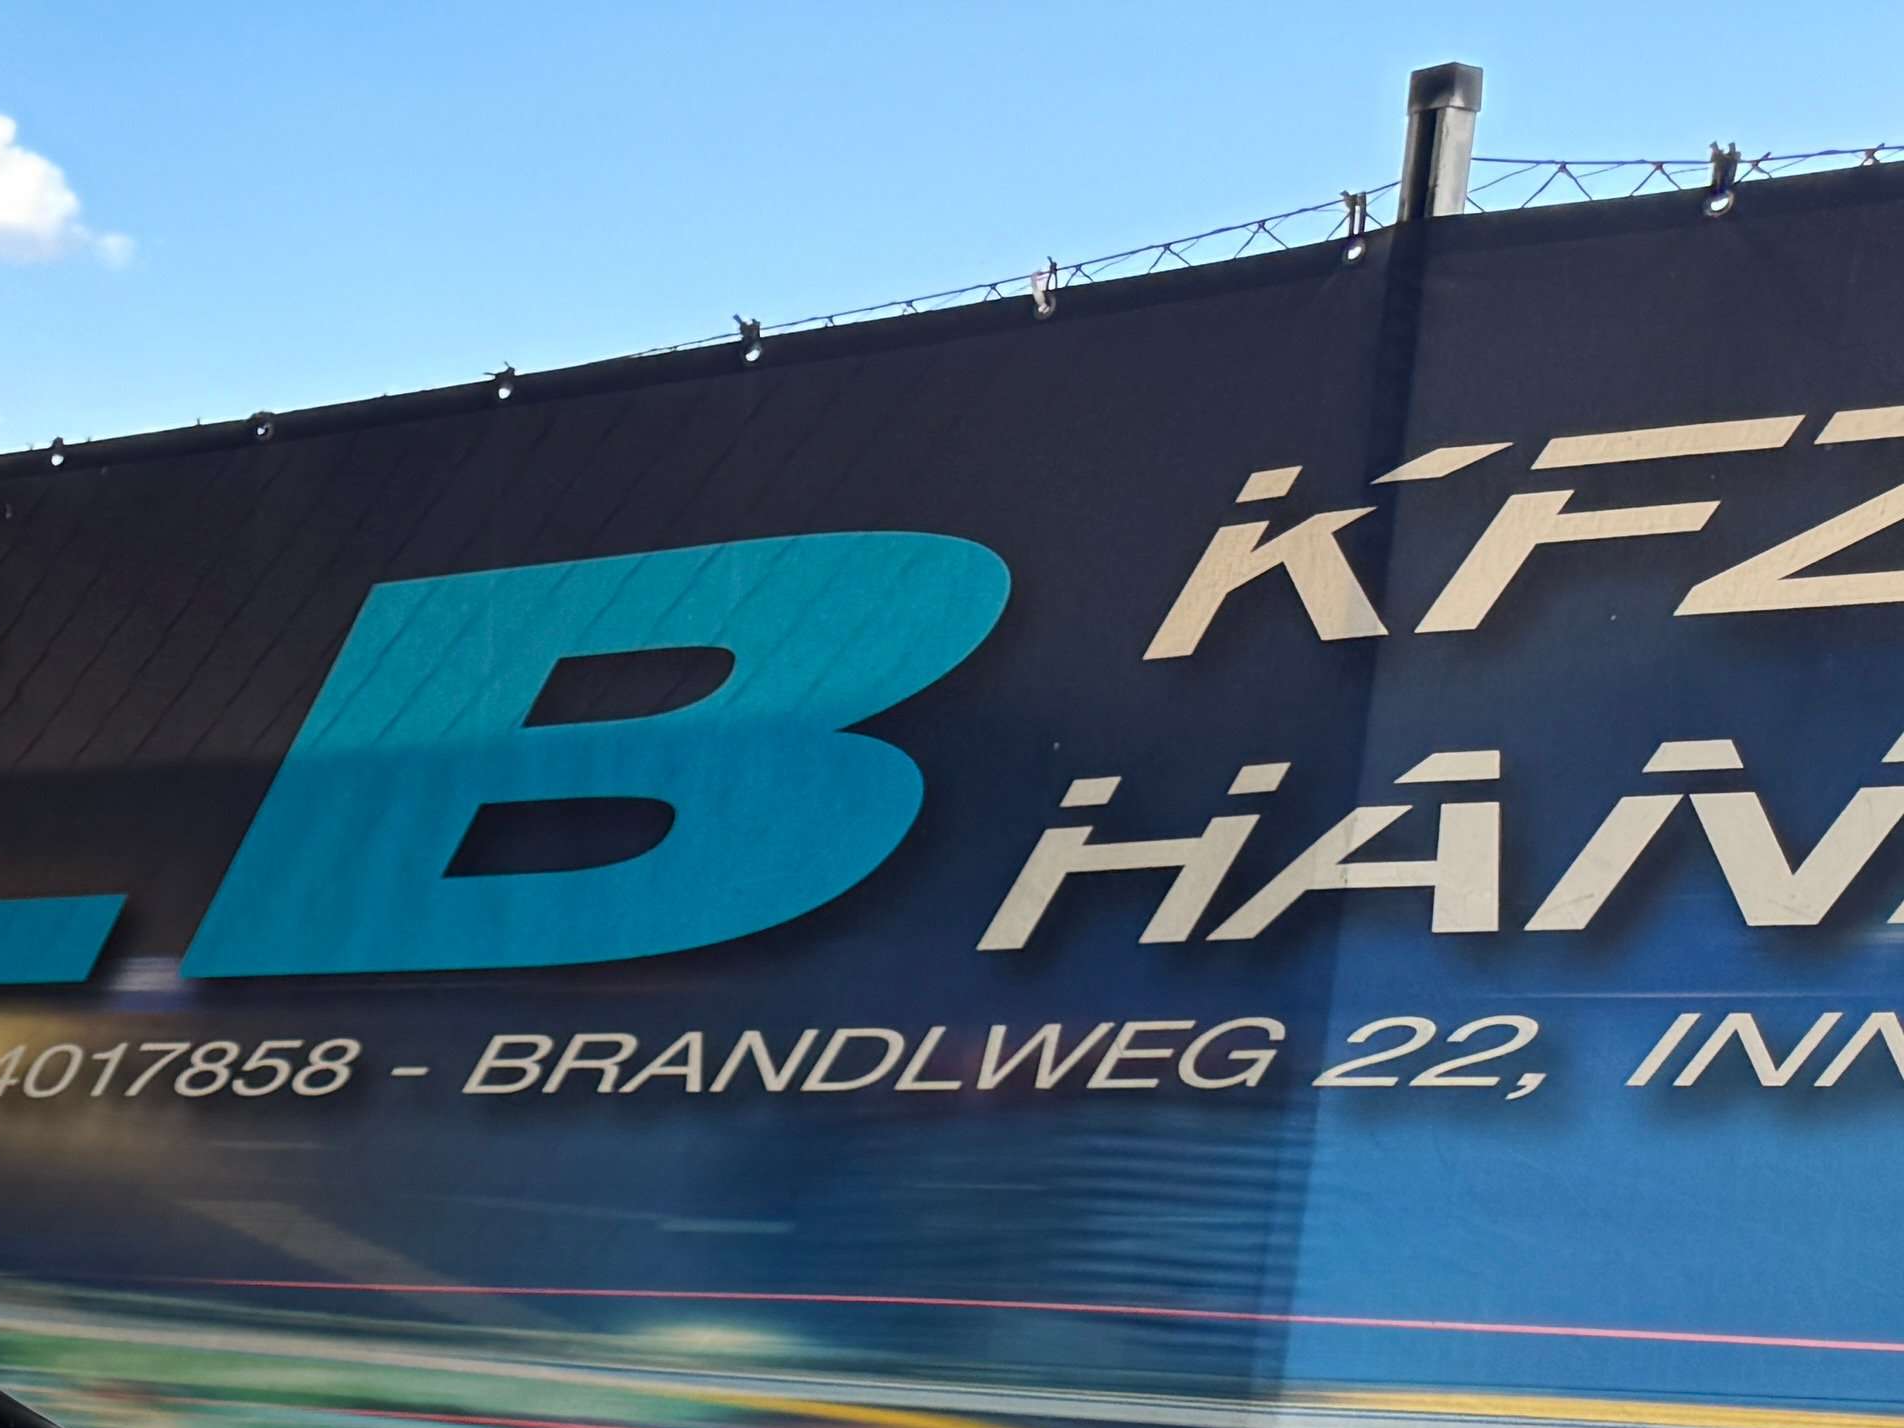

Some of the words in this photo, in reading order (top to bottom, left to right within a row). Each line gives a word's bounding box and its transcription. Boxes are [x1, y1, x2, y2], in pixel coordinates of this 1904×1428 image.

[1142, 405, 1904, 660] KFZ
[462, 1015, 1287, 1098] BRANDLWEG
[1312, 1015, 1548, 1101] 22,
